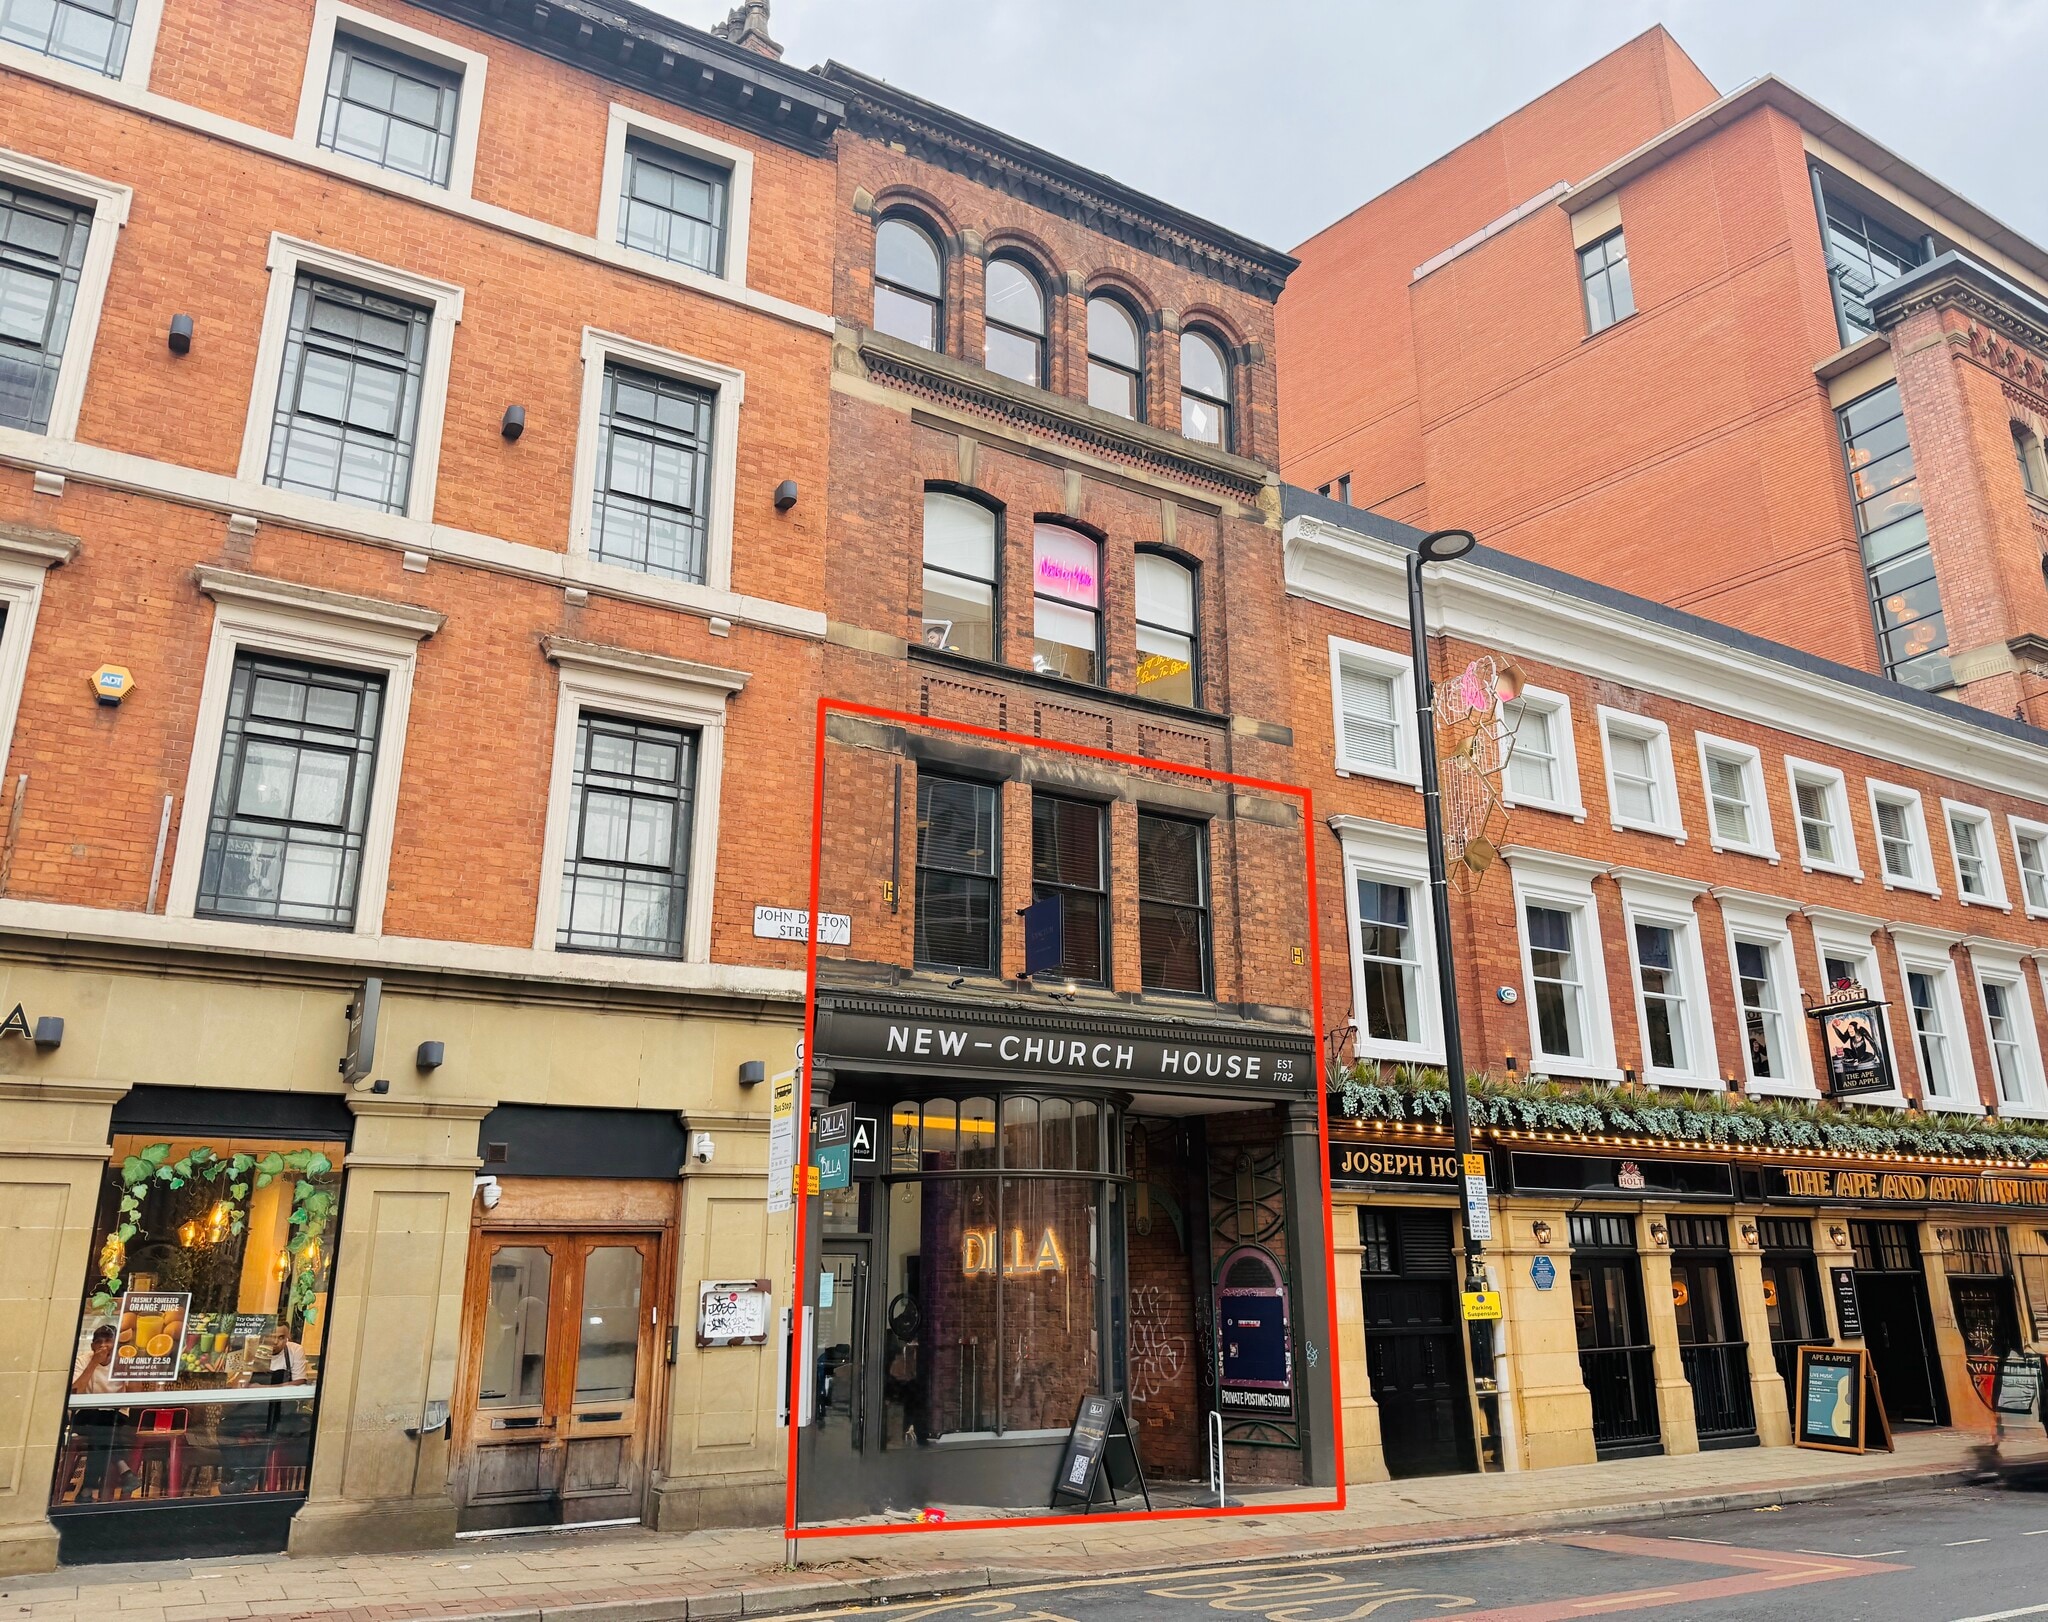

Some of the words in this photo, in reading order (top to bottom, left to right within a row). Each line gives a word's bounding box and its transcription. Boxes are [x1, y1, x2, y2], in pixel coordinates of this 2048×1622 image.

[101, 676, 122, 686] ADT
[757, 909, 793, 923] JOHN
[798, 913, 849, 933] DTON
[780, 925, 826, 940] STRET
[1830, 991, 1864, 1004] HOLT
[1161, 1049, 1261, 1080] HOUSE
[1277, 1059, 1293, 1070] EST
[1273, 1072, 1294, 1082] 1782
[1843, 1080, 1857, 1088] AND
[1859, 1077, 1880, 1085] APPLE
[782, 1102, 792, 1112] Stop
[821, 1114, 845, 1134] DILLA
[821, 1159, 842, 1175] DILLA
[1341, 1151, 1424, 1177] JOSEPH
[1430, 1156, 1458, 1179] HO
[1620, 1177, 1643, 1186] HOLT
[1783, 1169, 1832, 1196] THE
[1836, 1171, 1880, 1198] APE
[1882, 1174, 1926, 1200] AND
[129, 1303, 159, 1311] ORANGE
[160, 1304, 180, 1312] JUICE
[1221, 1390, 1244, 1404] PRIVATE
[1244, 1391, 1268, 1407] POSTING
[1267, 1393, 1291, 1408] STATION
